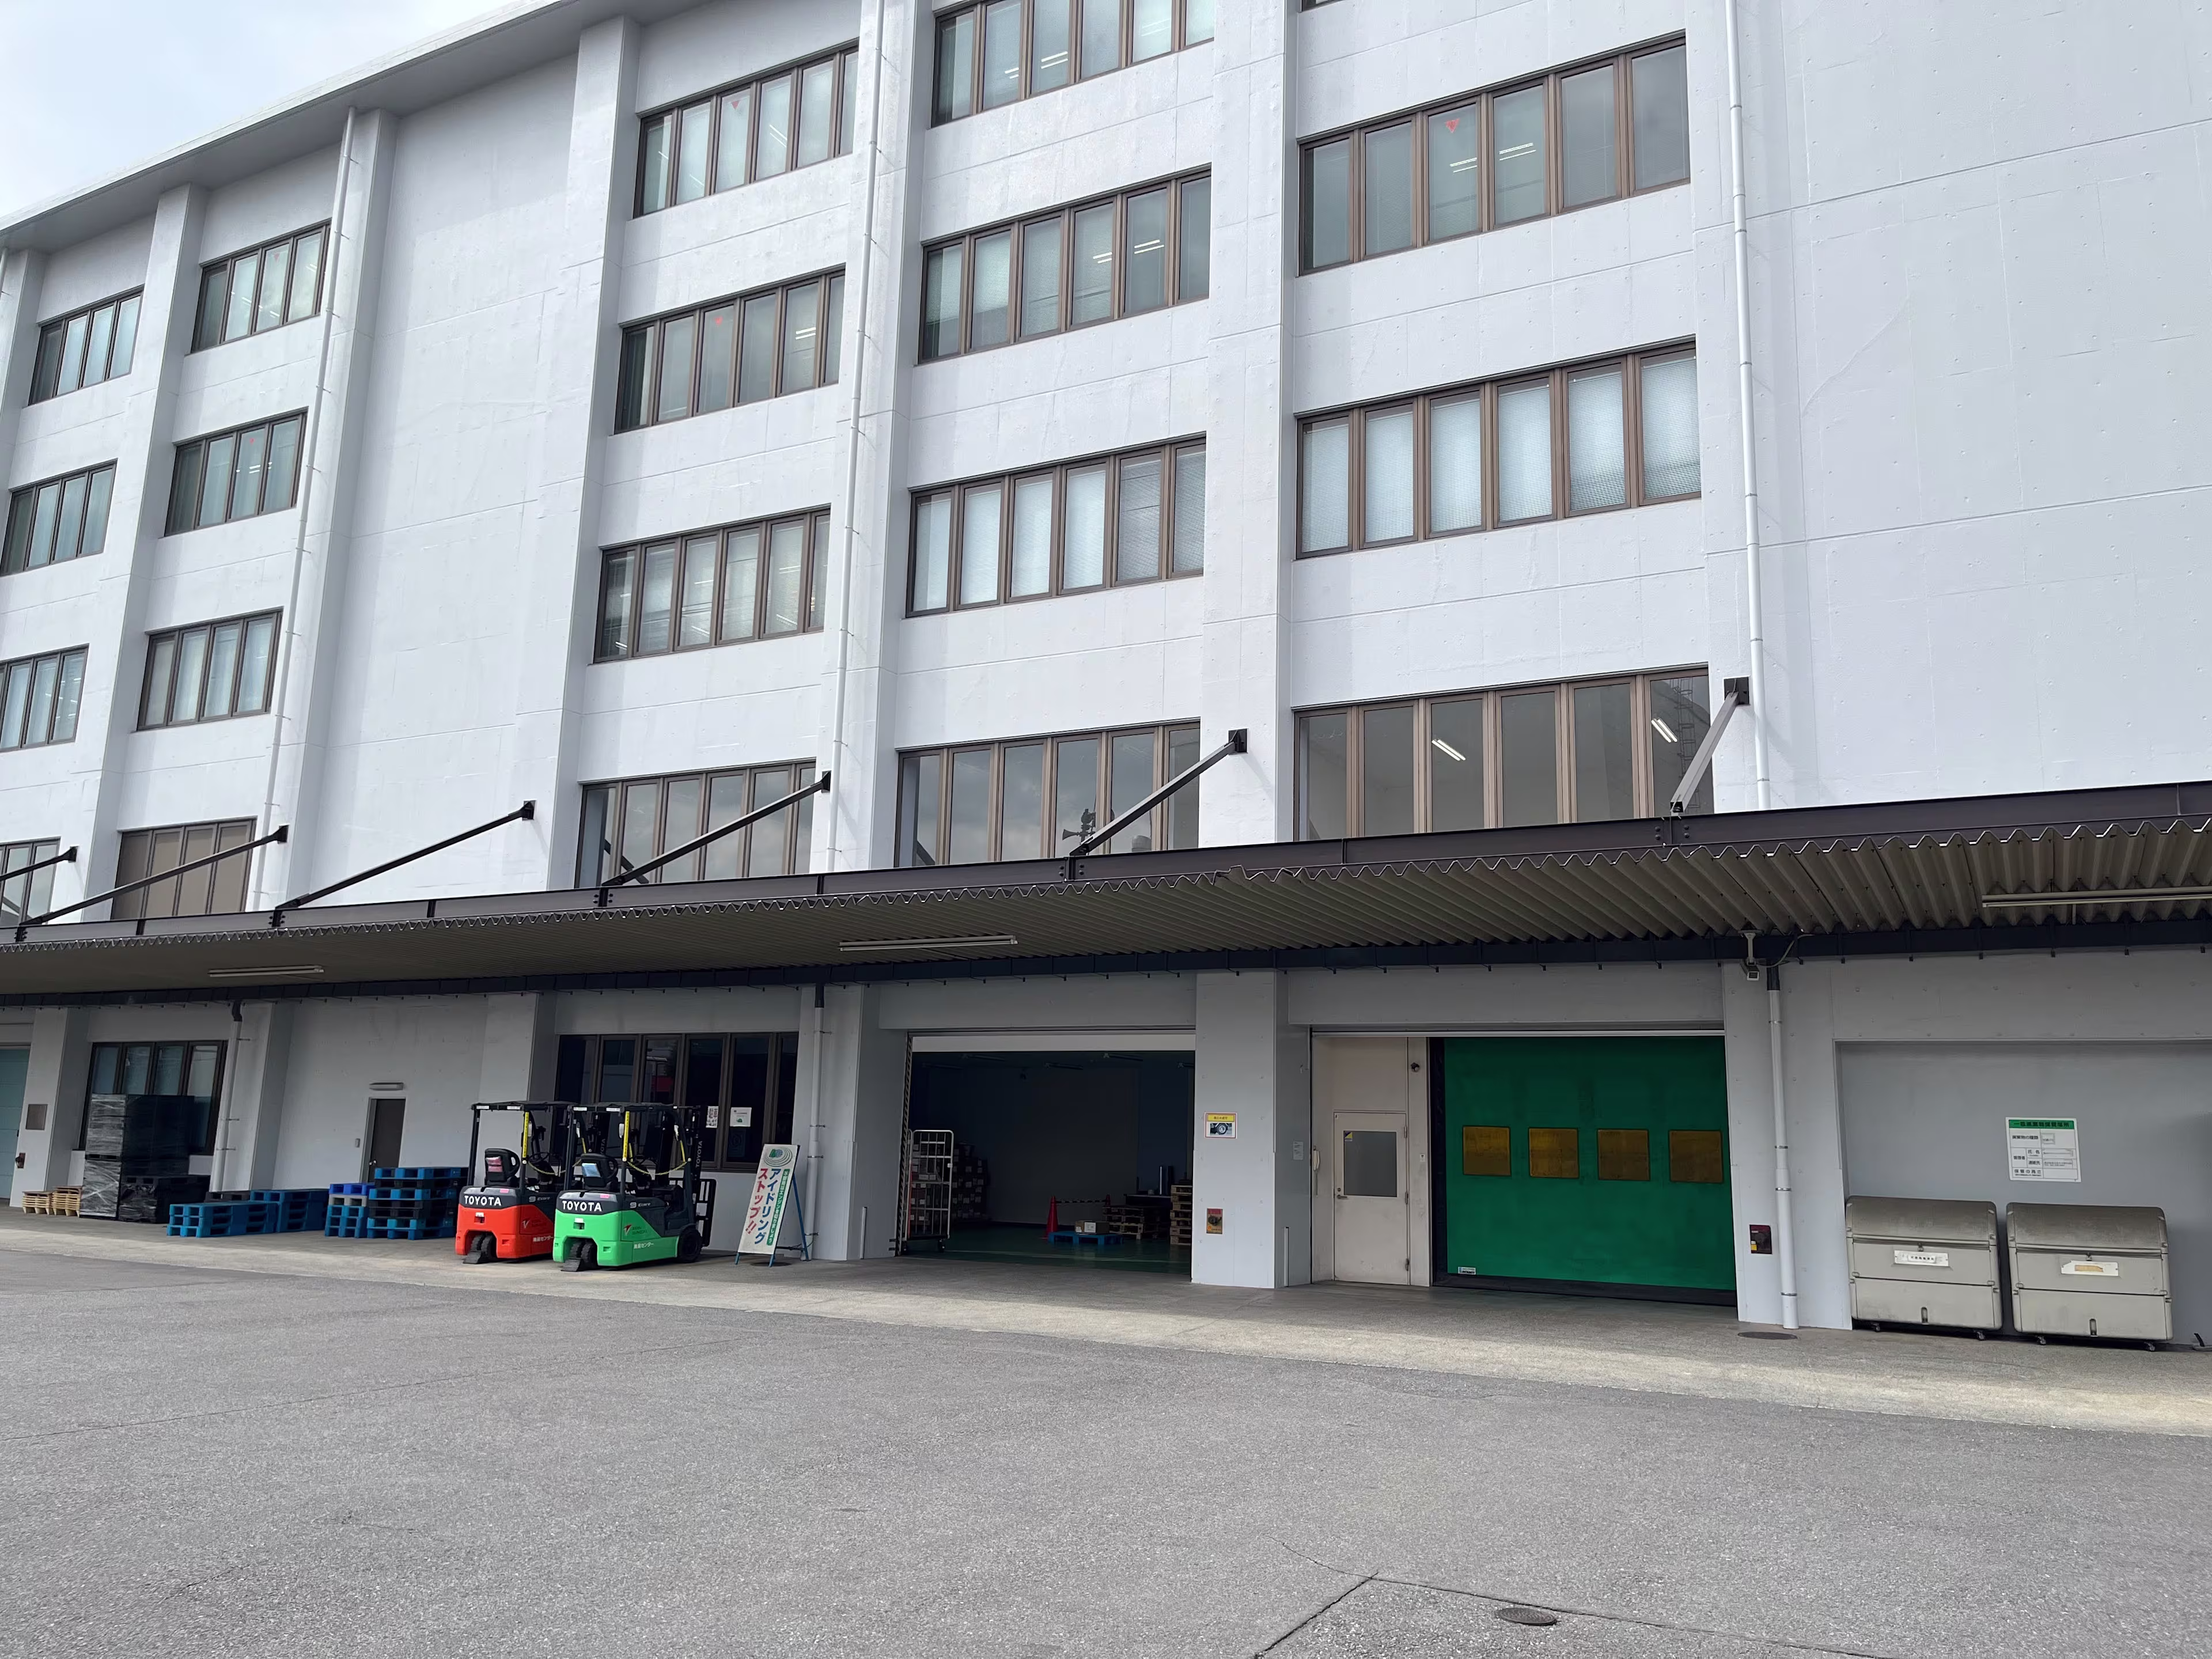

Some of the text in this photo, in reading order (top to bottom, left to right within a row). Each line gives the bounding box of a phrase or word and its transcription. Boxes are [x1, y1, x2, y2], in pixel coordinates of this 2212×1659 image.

[464, 1195, 502, 1206] TOYOTA
[562, 1200, 603, 1212] TOYOTA
[755, 1168, 781, 1244] アイドリング
